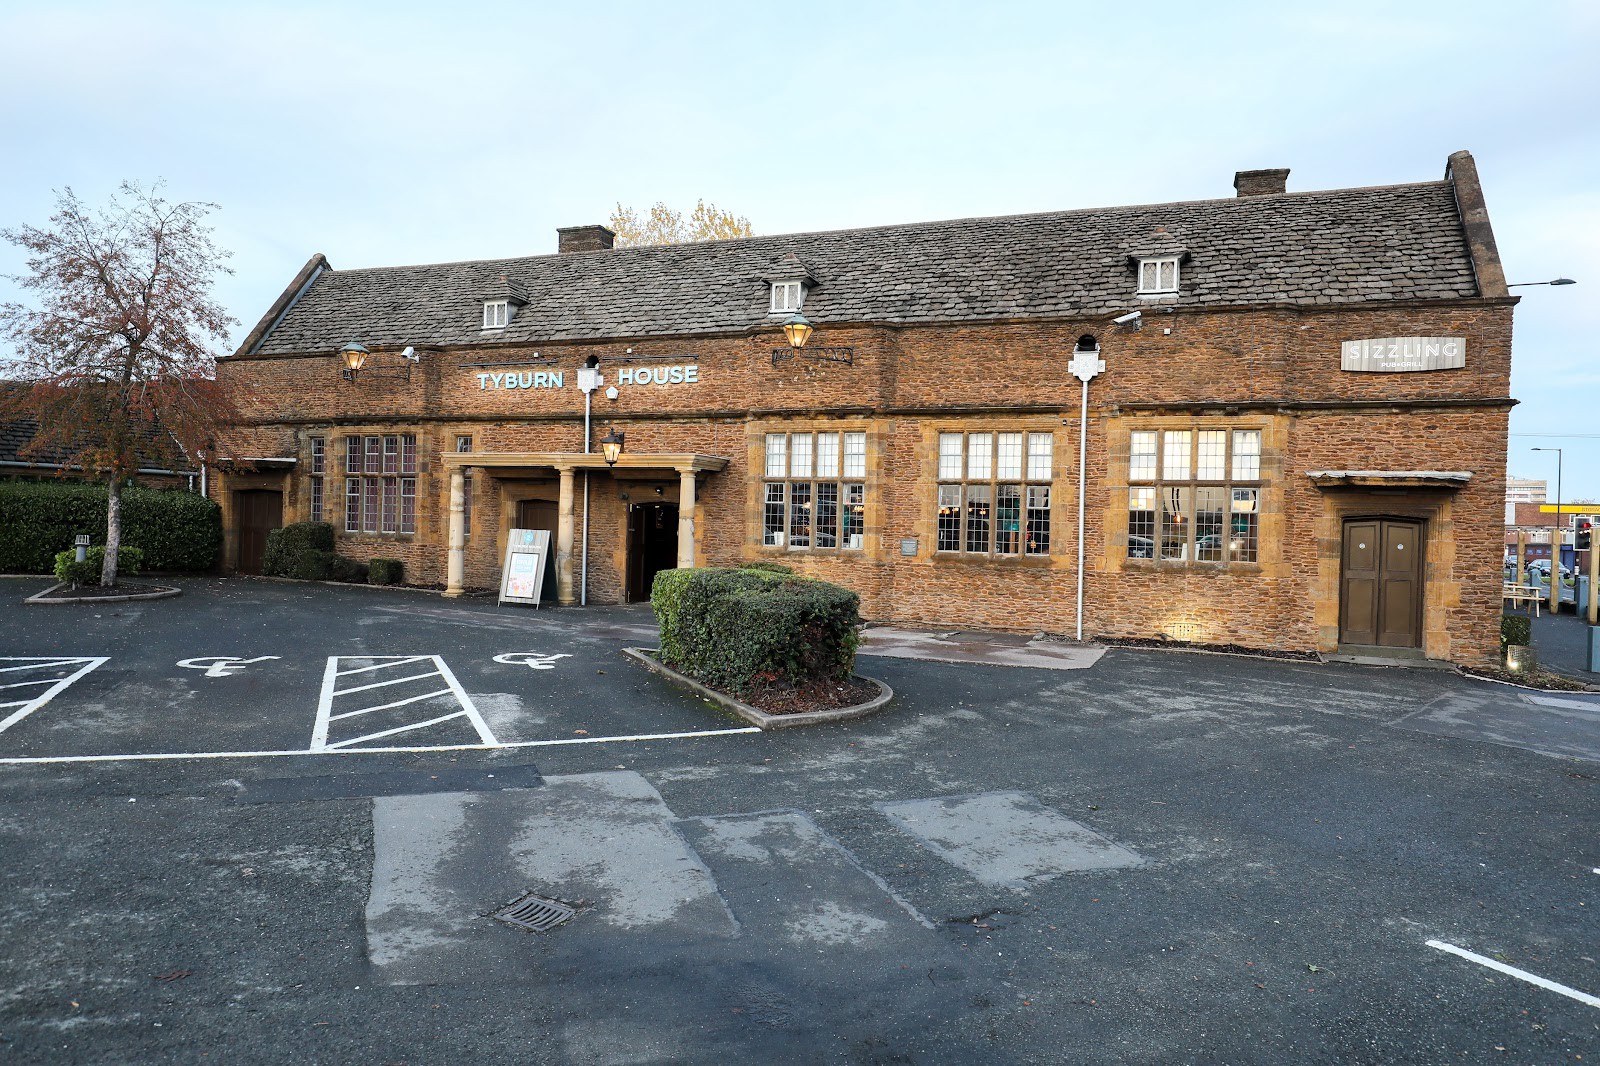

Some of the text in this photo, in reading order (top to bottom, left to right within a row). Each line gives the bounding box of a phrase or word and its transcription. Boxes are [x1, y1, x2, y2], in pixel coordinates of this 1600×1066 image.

[1349, 343, 1458, 359] SIZZLING
[477, 365, 698, 390] TYBURN HOUSE
